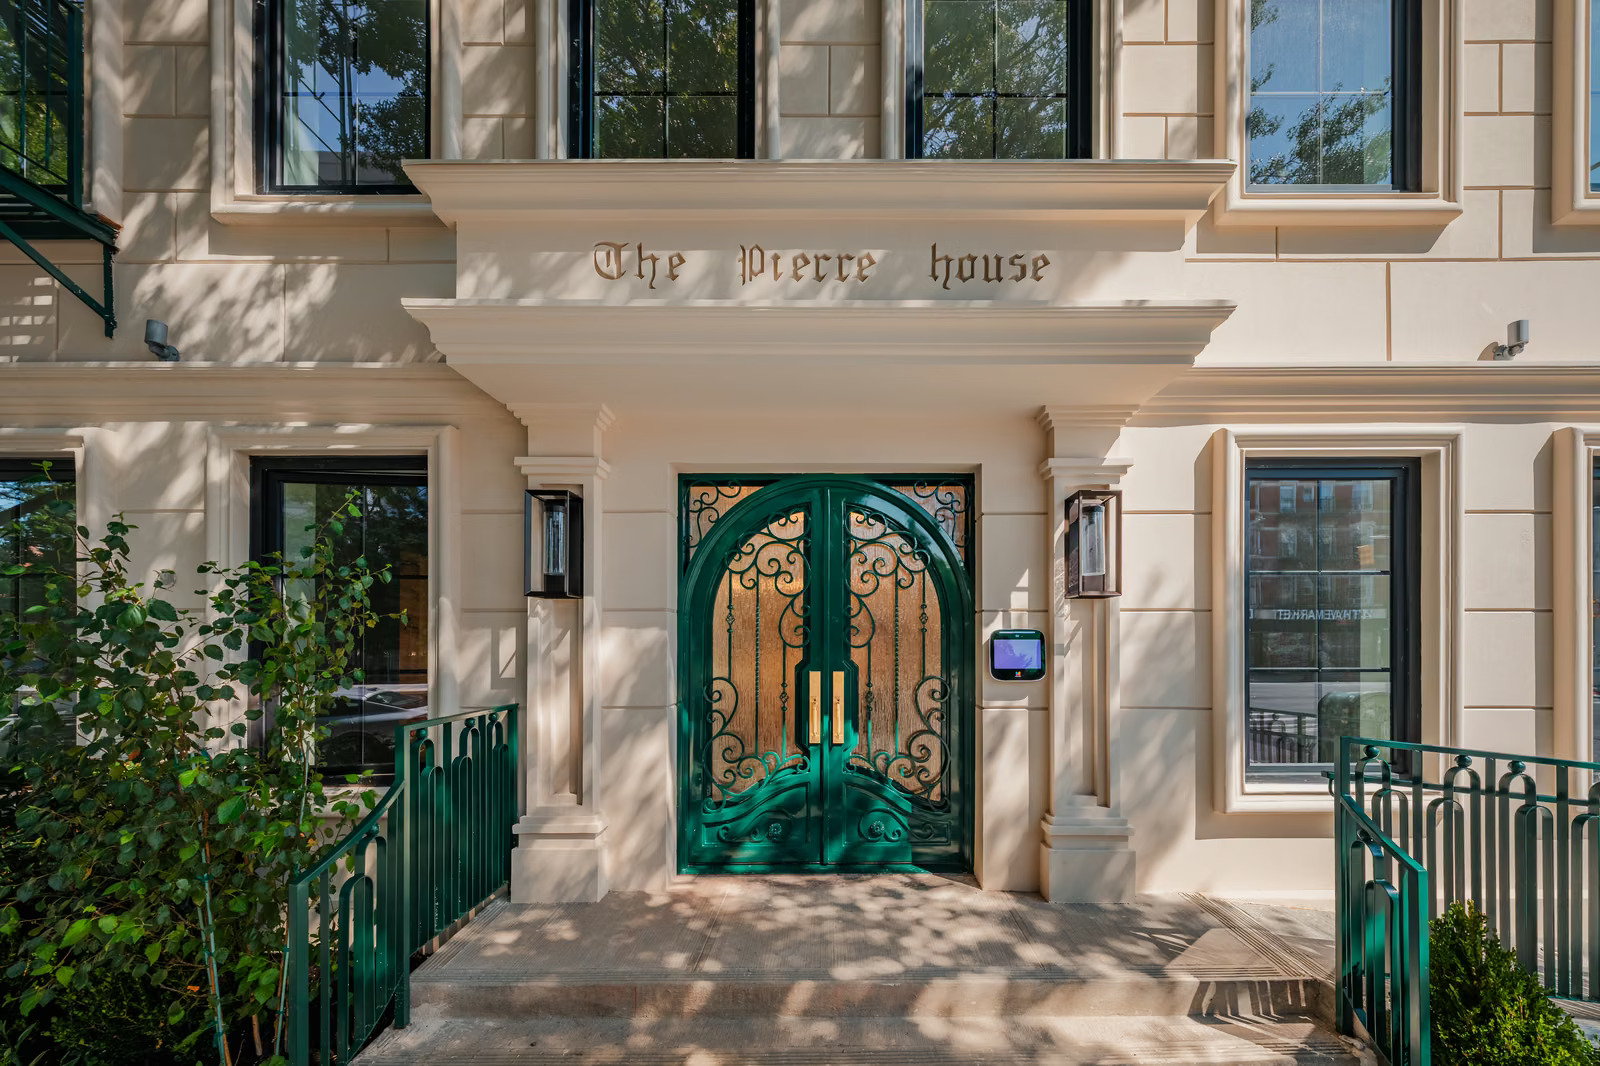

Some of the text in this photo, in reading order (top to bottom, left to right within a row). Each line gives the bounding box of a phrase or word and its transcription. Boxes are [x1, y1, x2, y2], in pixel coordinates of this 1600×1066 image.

[593, 241, 1051, 290] The Pierre house
